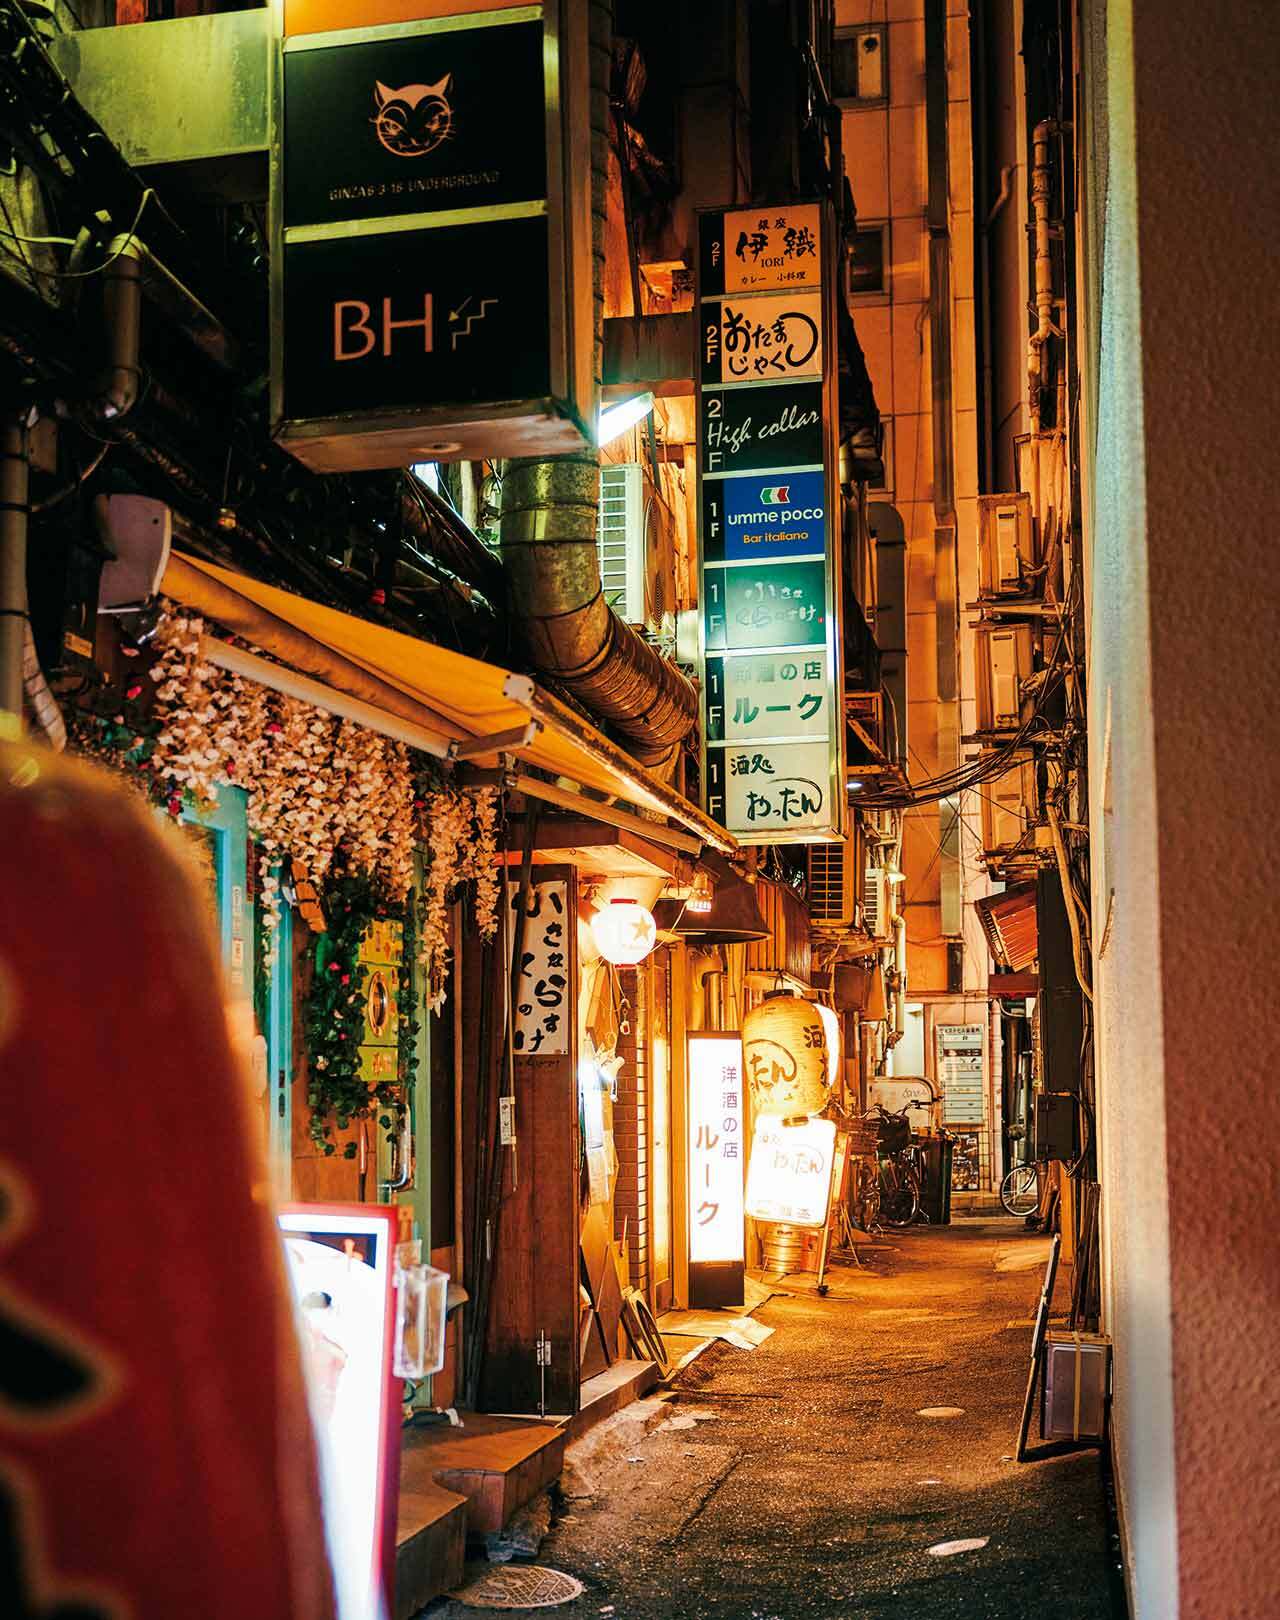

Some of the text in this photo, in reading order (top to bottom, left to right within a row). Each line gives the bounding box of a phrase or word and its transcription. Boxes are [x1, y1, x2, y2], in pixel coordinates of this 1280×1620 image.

[408, 171, 499, 192] UNDERGROUND
[711, 242, 720, 267] 2F
[736, 226, 816, 263] 伊織
[761, 257, 784, 268] IORI
[334, 293, 432, 360] BH
[707, 326, 718, 363] 2F
[708, 405, 819, 454] High collar
[710, 502, 719, 538] 1F
[728, 508, 823, 525] umme poco
[743, 531, 808, 544] Bar italiano
[710, 584, 722, 633] 1F
[709, 674, 722, 724] 1F
[732, 694, 823, 724] ルーク
[730, 754, 775, 776] 酒処
[709, 764, 722, 815] 1F
[722, 1065, 738, 1158] 洋酒の店
[696, 1123, 719, 1226] ルーク
